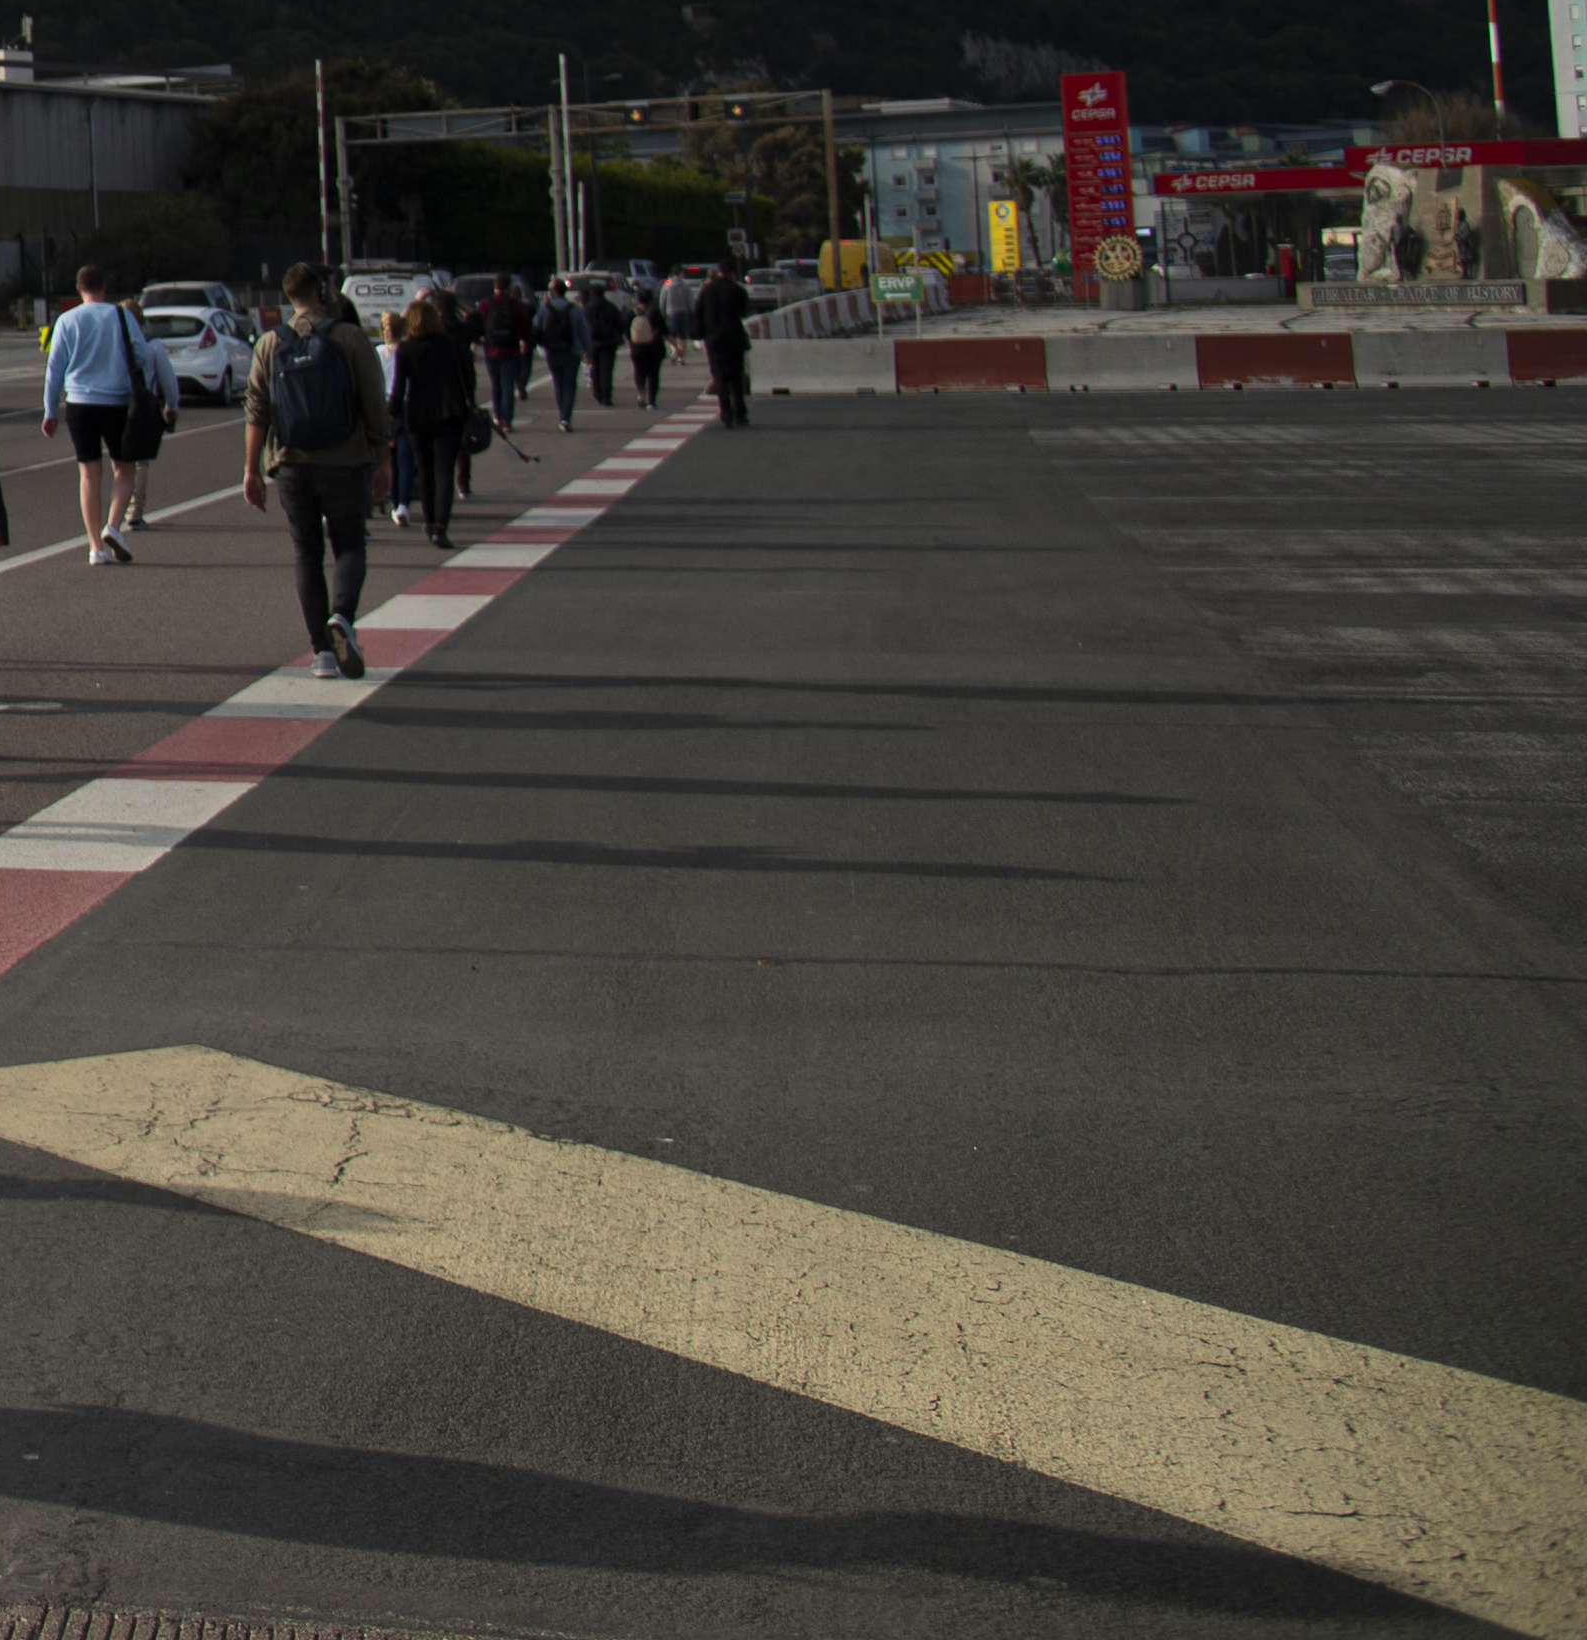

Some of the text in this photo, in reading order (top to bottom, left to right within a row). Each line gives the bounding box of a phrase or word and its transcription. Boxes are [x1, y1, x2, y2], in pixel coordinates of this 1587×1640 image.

[1071, 107, 1117, 122] CEPSA
[1395, 146, 1472, 165] CEPSA
[1194, 173, 1256, 190] CEPSA
[355, 284, 404, 296] OSG
[878, 276, 917, 290] ERVP
[1313, 285, 1520, 302] GIBRALTAR CRADLE OF HISTORY
